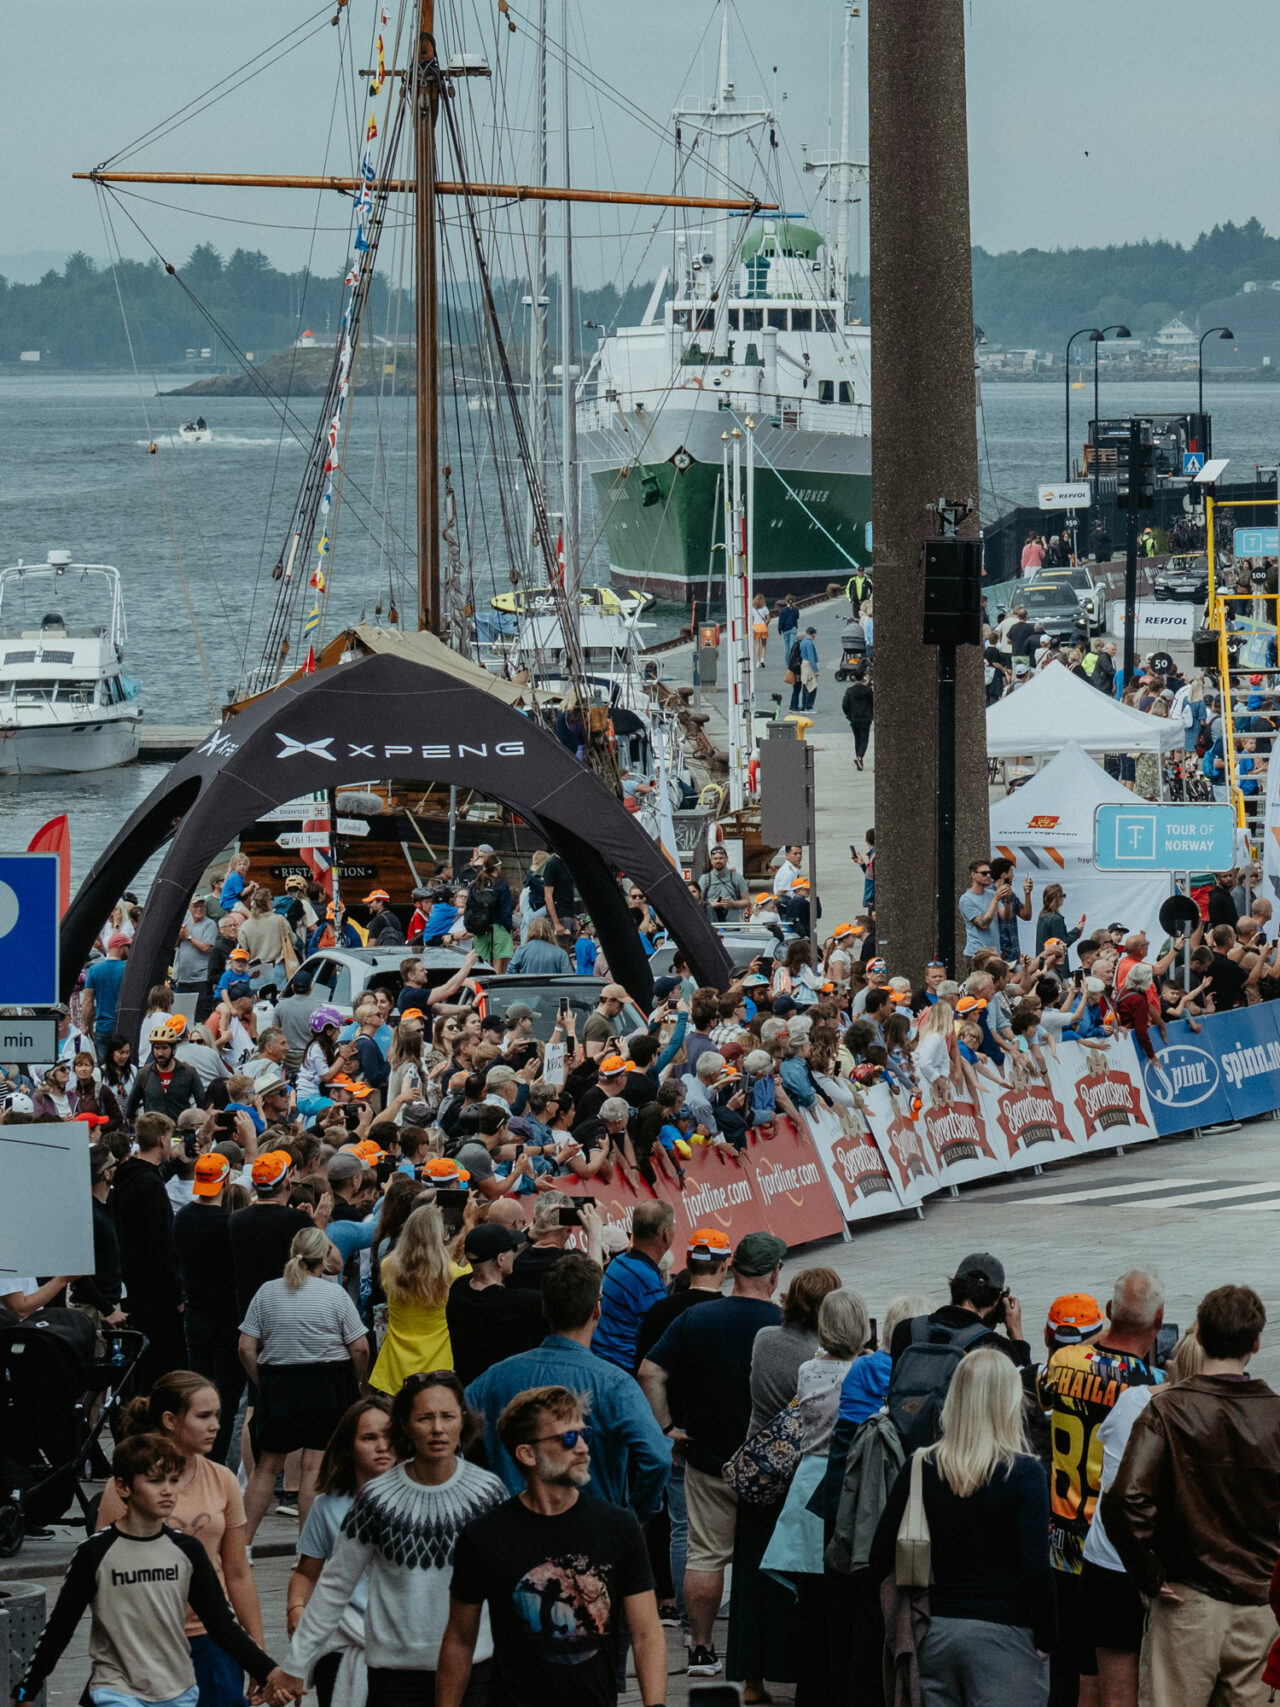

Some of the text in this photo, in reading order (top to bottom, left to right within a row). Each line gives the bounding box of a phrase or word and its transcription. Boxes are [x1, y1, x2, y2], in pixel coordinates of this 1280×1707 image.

[1252, 571, 1267, 579] 100
[1145, 616, 1188, 625] REPSOL
[1154, 659, 1169, 668] 50
[347, 740, 526, 759] XPENG
[1165, 824, 1215, 835] TOUR OF
[291, 835, 325, 845] Old Town
[1164, 840, 1215, 852] NORWAY
[281, 866, 366, 878] RESTATION
[4, 1032, 34, 1048] min
[1153, 1050, 1211, 1103] Spinn
[1079, 1075, 1134, 1119] Berentsens
[1003, 1091, 1058, 1136] Berentsens
[1100, 1112, 1128, 1127] EPLEMOST
[927, 1107, 980, 1152] Berentsens
[1023, 1129, 1051, 1144] EPLEMOST
[756, 1161, 821, 1206] fjordline.com
[681, 1178, 753, 1228] fjordline.com
[111, 1563, 179, 1587] hummel
